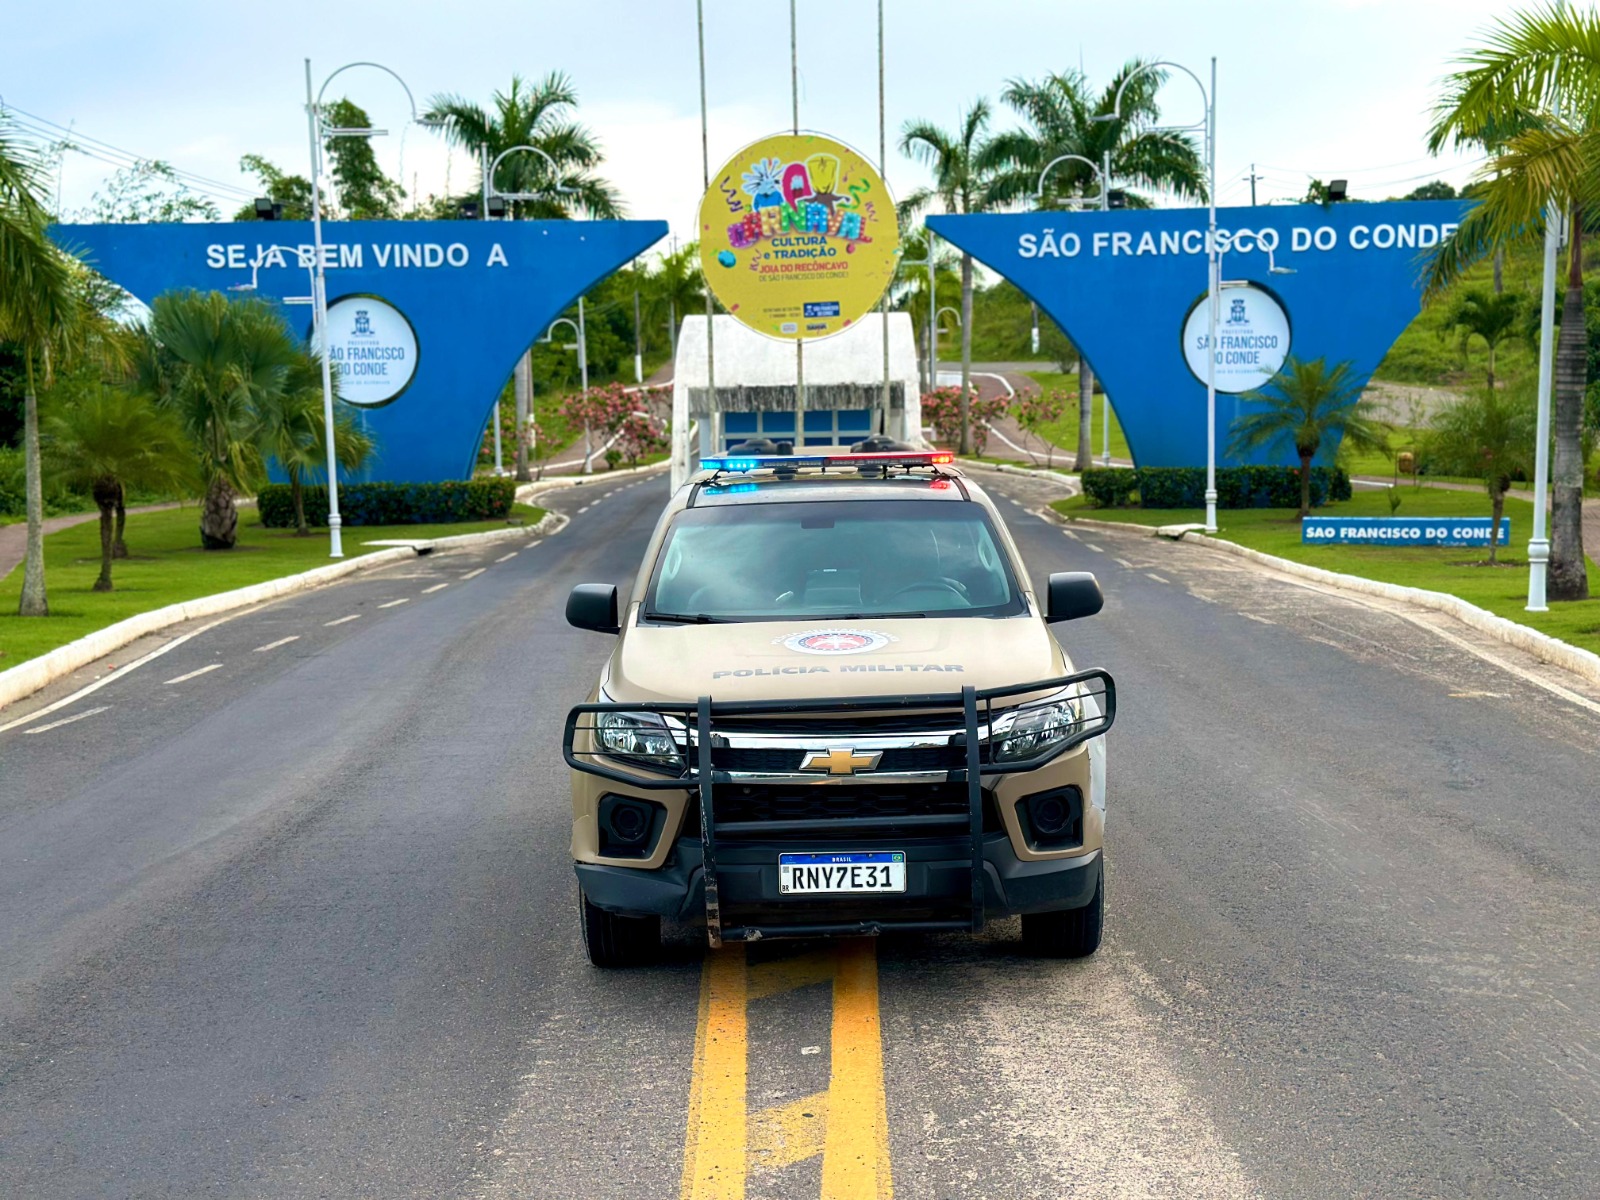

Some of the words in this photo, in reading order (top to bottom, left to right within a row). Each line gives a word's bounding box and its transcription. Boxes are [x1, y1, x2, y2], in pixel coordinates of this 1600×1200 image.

[727, 200, 872, 248] CARNAVAL
[771, 236, 828, 247] CULTURA
[1017, 228, 1081, 258] SÃO
[1092, 227, 1279, 257] FRANCISCO
[1291, 225, 1337, 252] DO
[206, 244, 287, 269] SEJA
[297, 243, 363, 268] BEM
[372, 242, 469, 268] VINDO
[486, 243, 509, 268] A
[773, 245, 837, 259] TRADIÇÃO
[760, 265, 779, 273] JOIA
[780, 264, 793, 272] DO
[794, 260, 849, 272] RECÔNCAVO
[768, 273, 780, 281] SÃO
[781, 272, 816, 281] FRANCISCO
[1220, 335, 1278, 349] FRANCISCO
[327, 345, 344, 361] ÃO
[347, 347, 405, 361] FRANCISCO
[1225, 351, 1260, 365] CONDE
[336, 362, 351, 376] DO
[353, 362, 388, 376] CONDE
[1305, 527, 1336, 539] SAO
[1339, 527, 1421, 540] FRANCISCO
[1425, 527, 1447, 539] DO
[712, 665, 830, 679] POLÍCIA
[839, 664, 965, 673] MILITAR
[792, 865, 892, 889] RNY7E31
